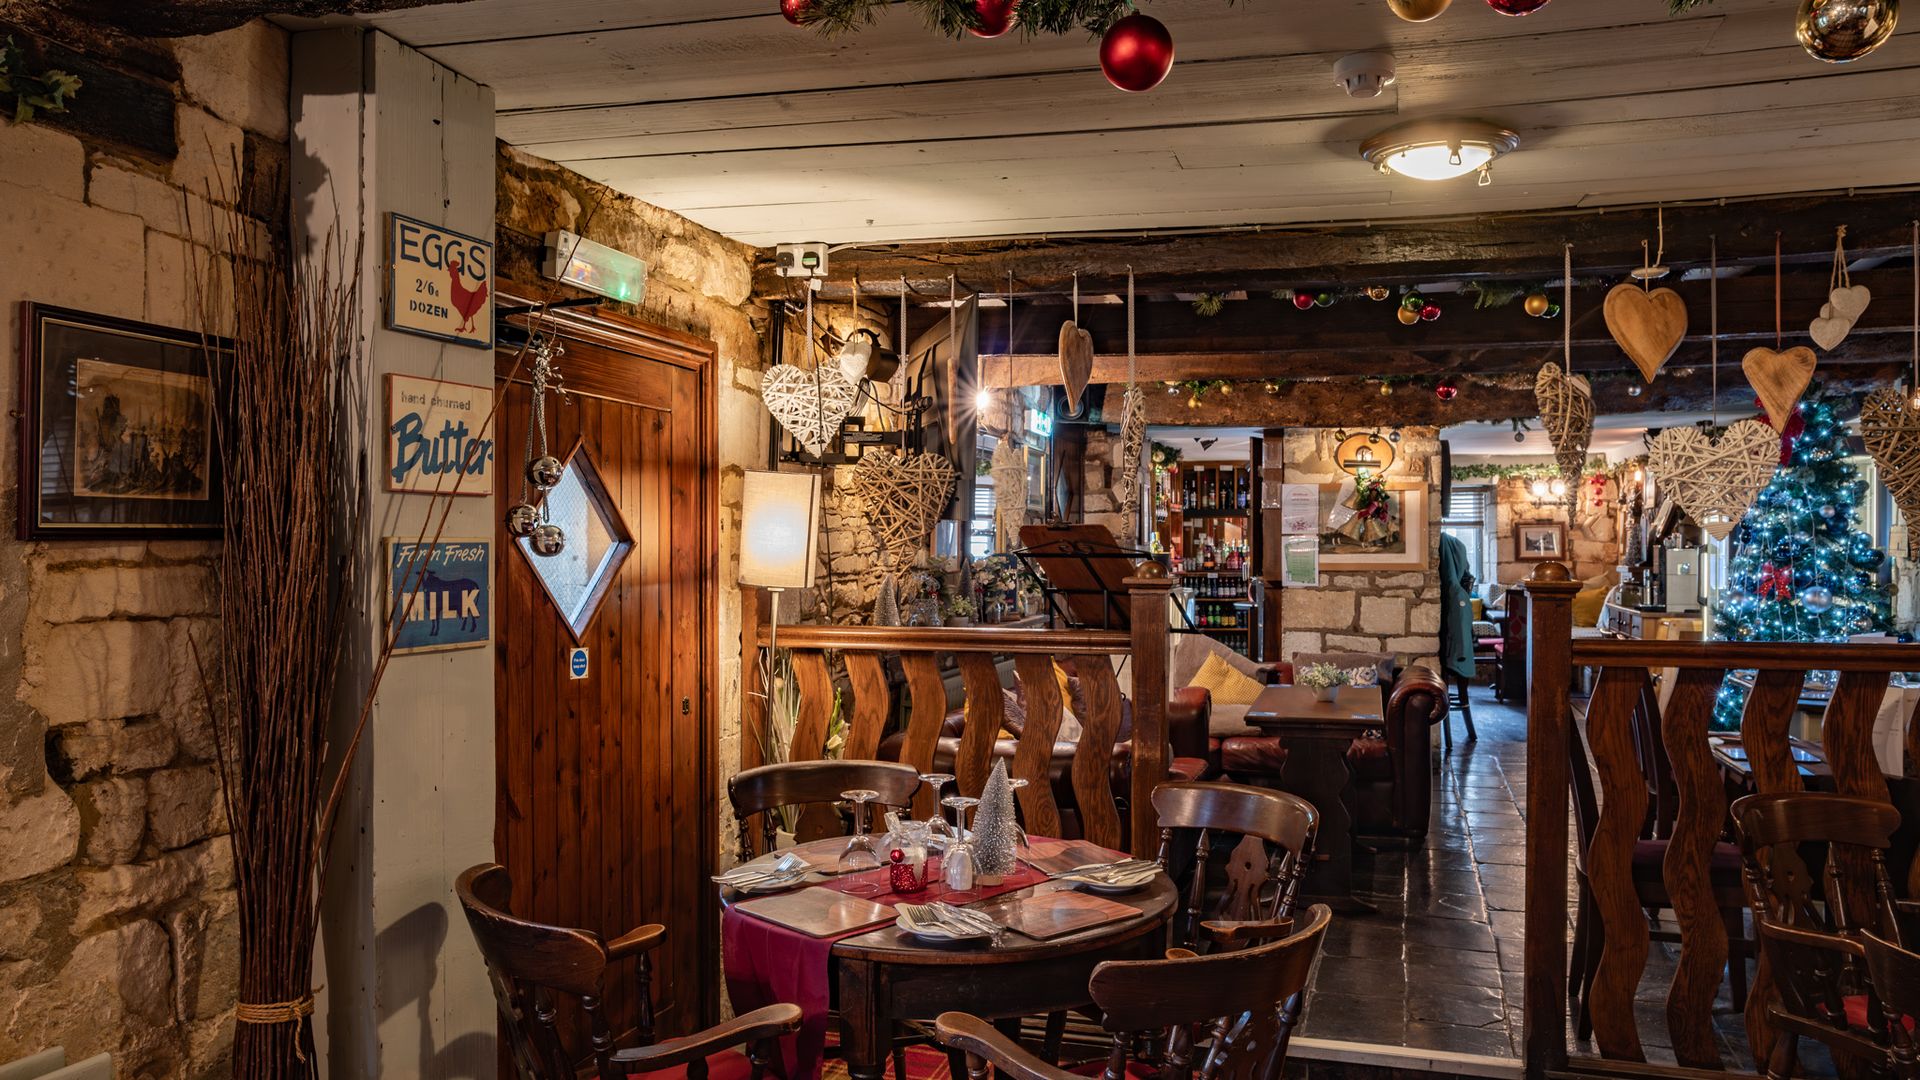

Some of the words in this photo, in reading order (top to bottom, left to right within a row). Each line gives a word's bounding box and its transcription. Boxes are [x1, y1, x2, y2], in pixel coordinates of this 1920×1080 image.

[400, 223, 487, 282] EGGS
[409, 299, 449, 319] DOZEN
[401, 392, 425, 406] hand
[430, 396, 471, 411] churned
[391, 412, 493, 484] Butter
[443, 544, 485, 566] Fresh
[402, 589, 480, 622] MILK
